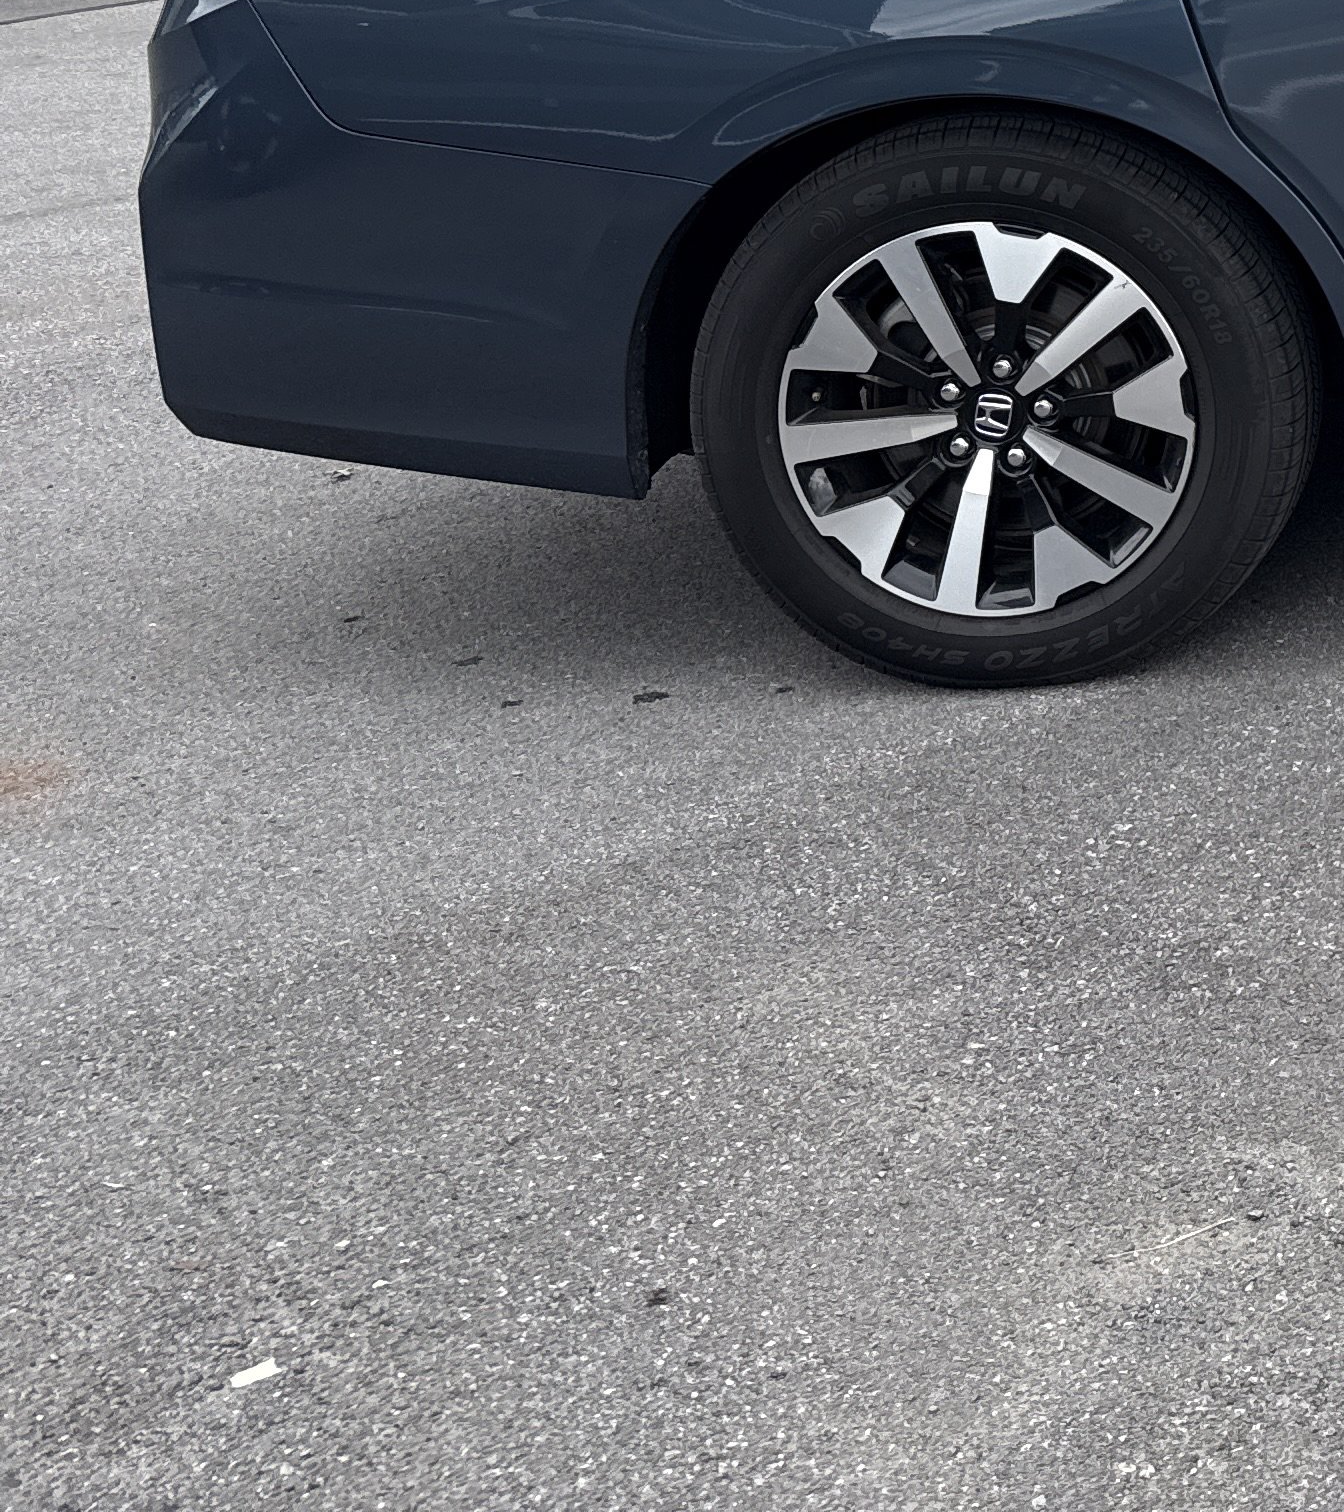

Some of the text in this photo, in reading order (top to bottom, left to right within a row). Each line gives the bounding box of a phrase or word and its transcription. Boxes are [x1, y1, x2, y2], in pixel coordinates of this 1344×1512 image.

[852, 165, 1086, 218] SAILUN
[1132, 226, 1233, 345] 235/60R18
[837, 559, 1187, 671] ATREZZO SH408
